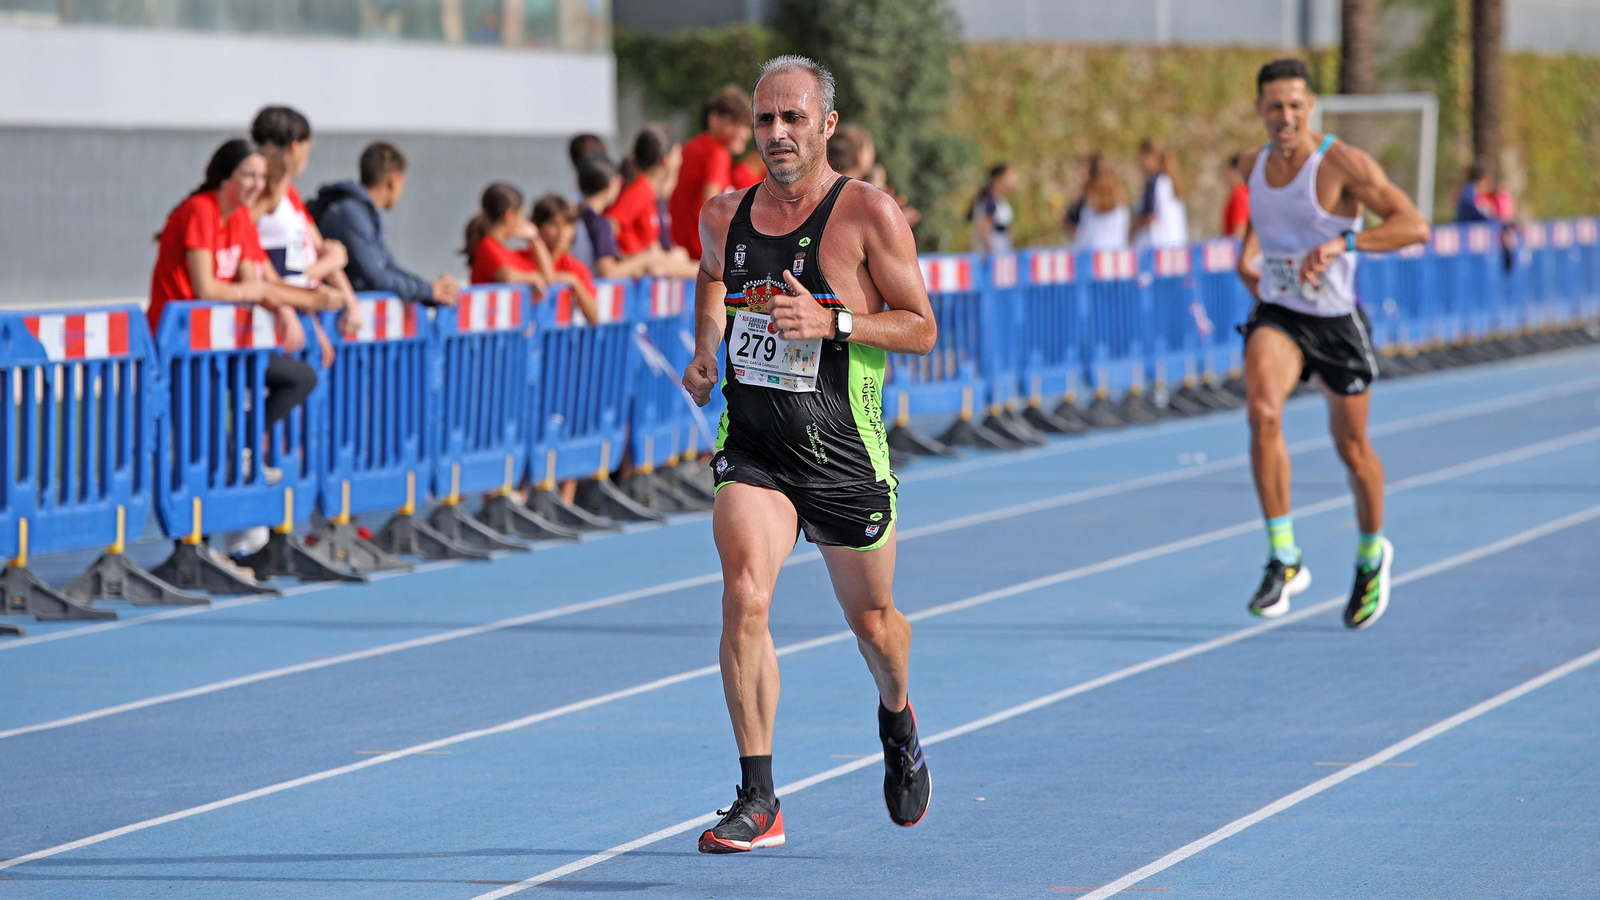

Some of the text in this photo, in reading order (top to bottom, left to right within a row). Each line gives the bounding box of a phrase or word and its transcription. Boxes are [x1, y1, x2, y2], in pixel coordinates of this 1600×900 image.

[749, 316, 768, 325] CARRERA
[748, 321, 767, 330] POPULAR
[736, 332, 776, 362] 279
